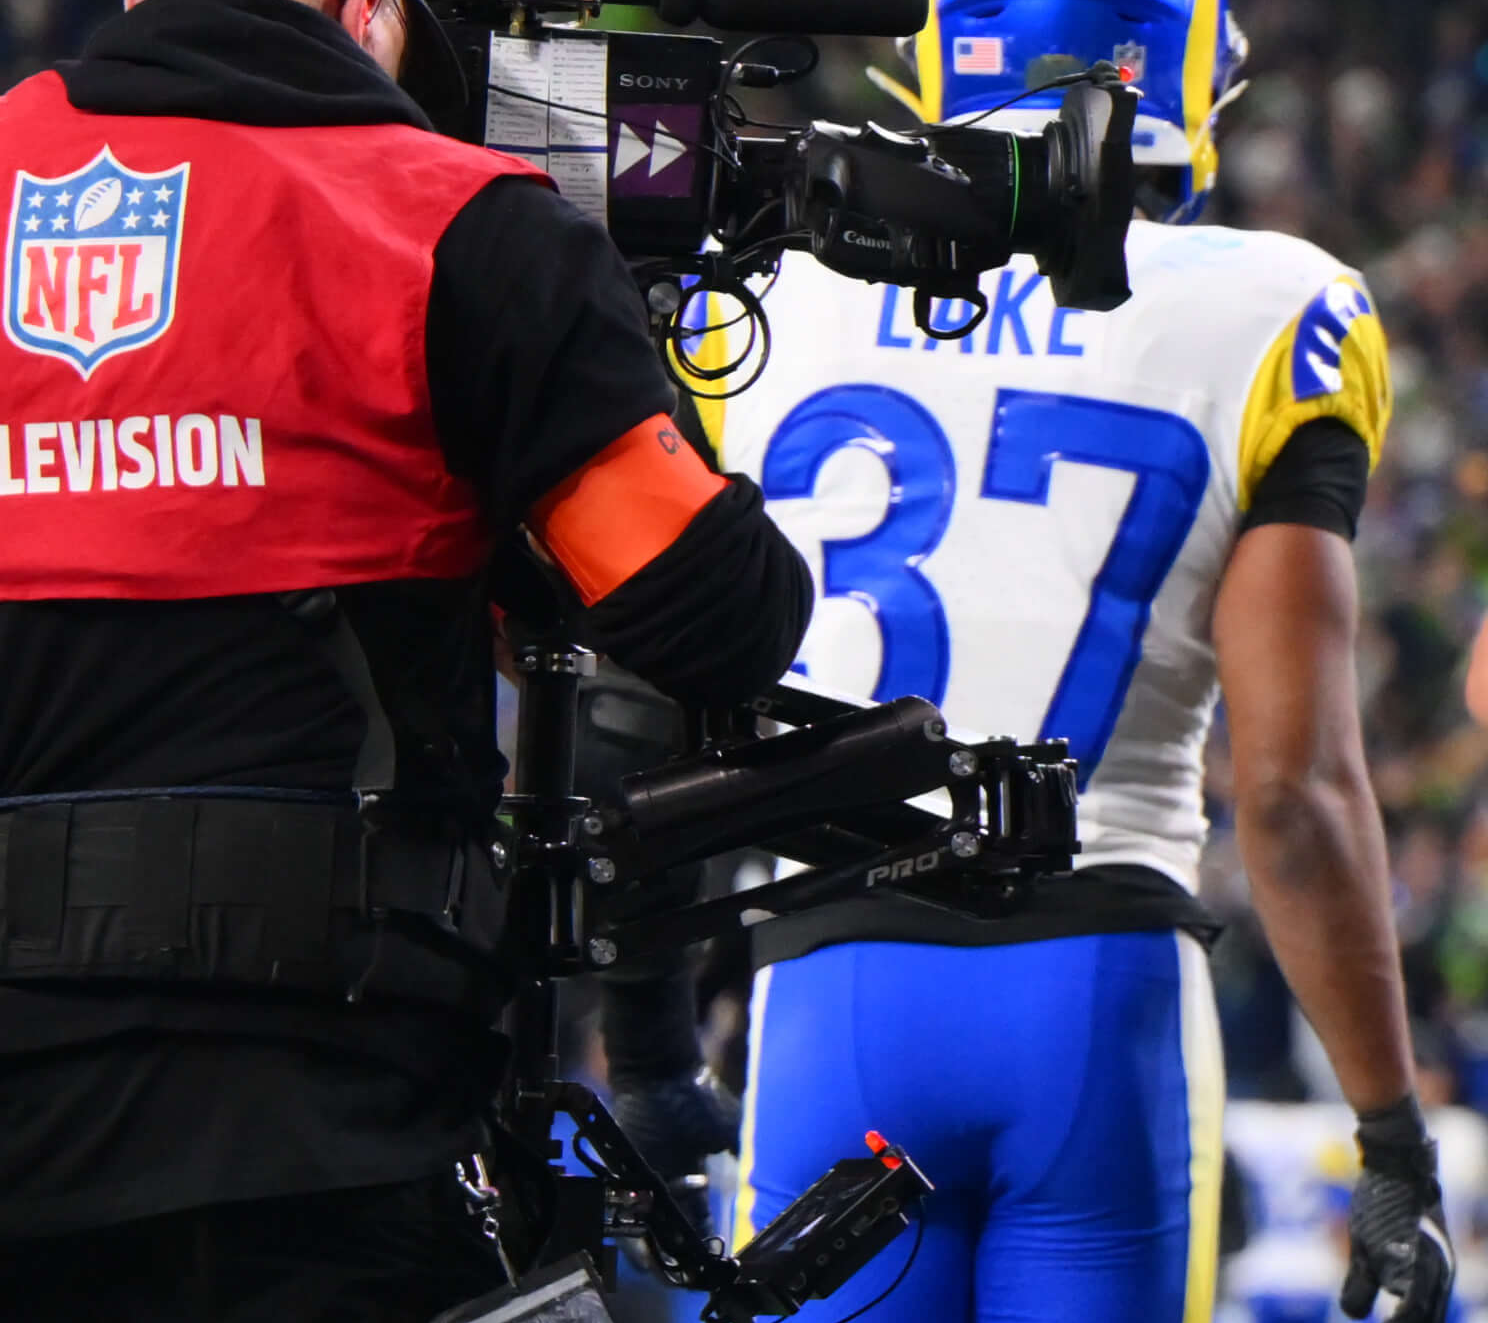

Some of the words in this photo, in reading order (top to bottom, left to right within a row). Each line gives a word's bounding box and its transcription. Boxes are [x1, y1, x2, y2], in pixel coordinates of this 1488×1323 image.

[619, 73, 690, 92] SONY
[22, 235, 156, 343] NFL
[876, 270, 1085, 356] LAKE
[0, 413, 266, 496] LEVISION
[761, 382, 1210, 794] 37
[866, 850, 939, 888] PRO
